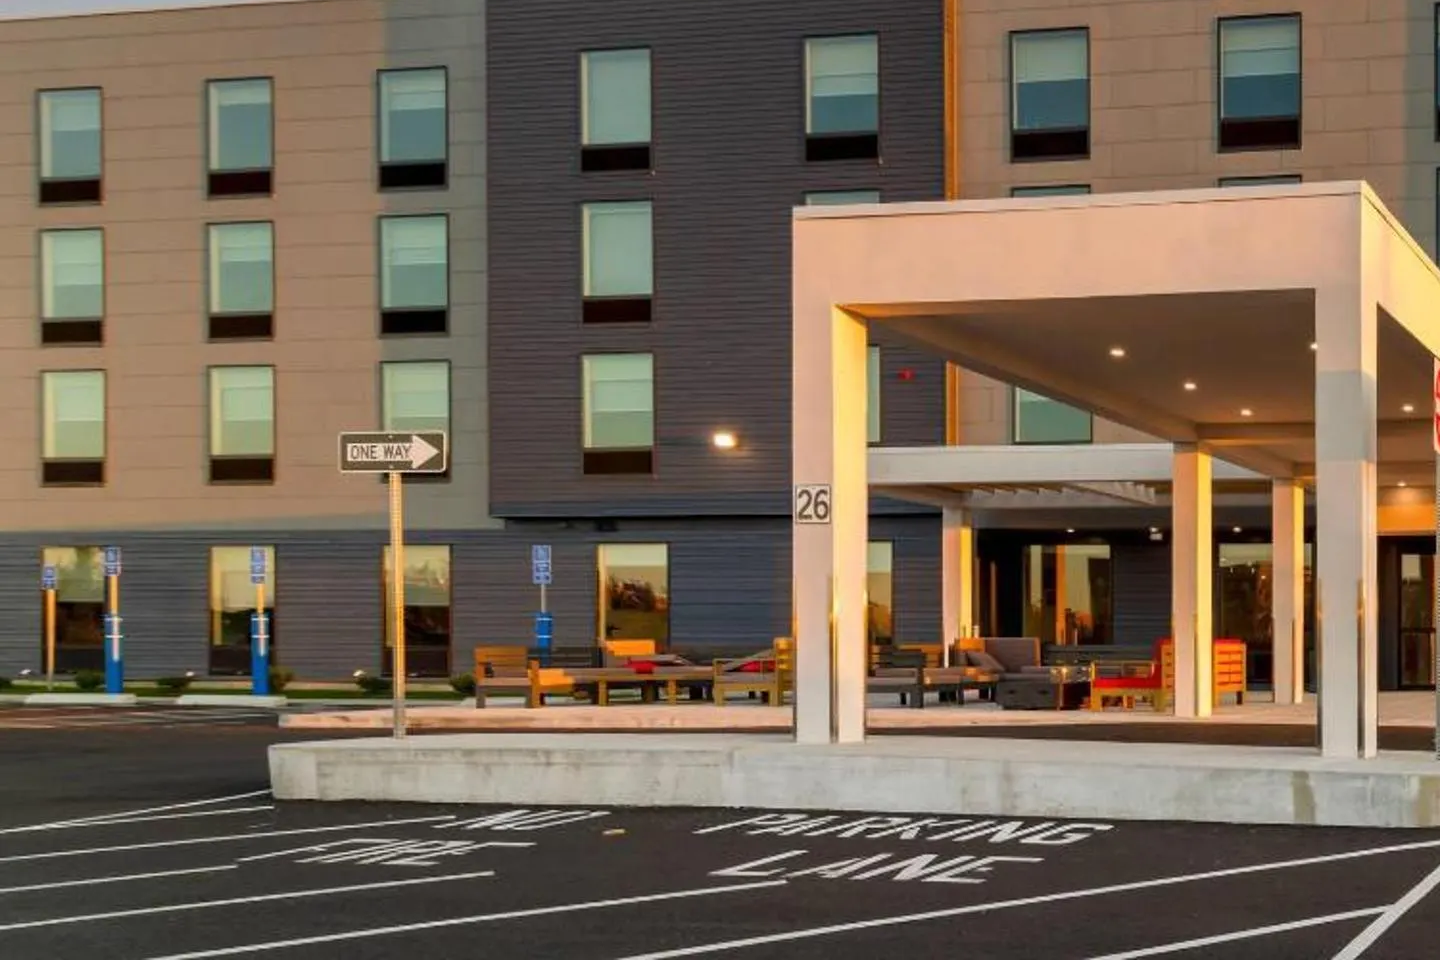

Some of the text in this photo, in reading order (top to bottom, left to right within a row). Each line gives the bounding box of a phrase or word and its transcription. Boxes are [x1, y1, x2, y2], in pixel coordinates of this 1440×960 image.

[350, 443, 412, 460] ONE WAY
[798, 489, 829, 520] 26
[431, 809, 1116, 846] NO PARKING
[235, 838, 1045, 884] FIRE LANE
